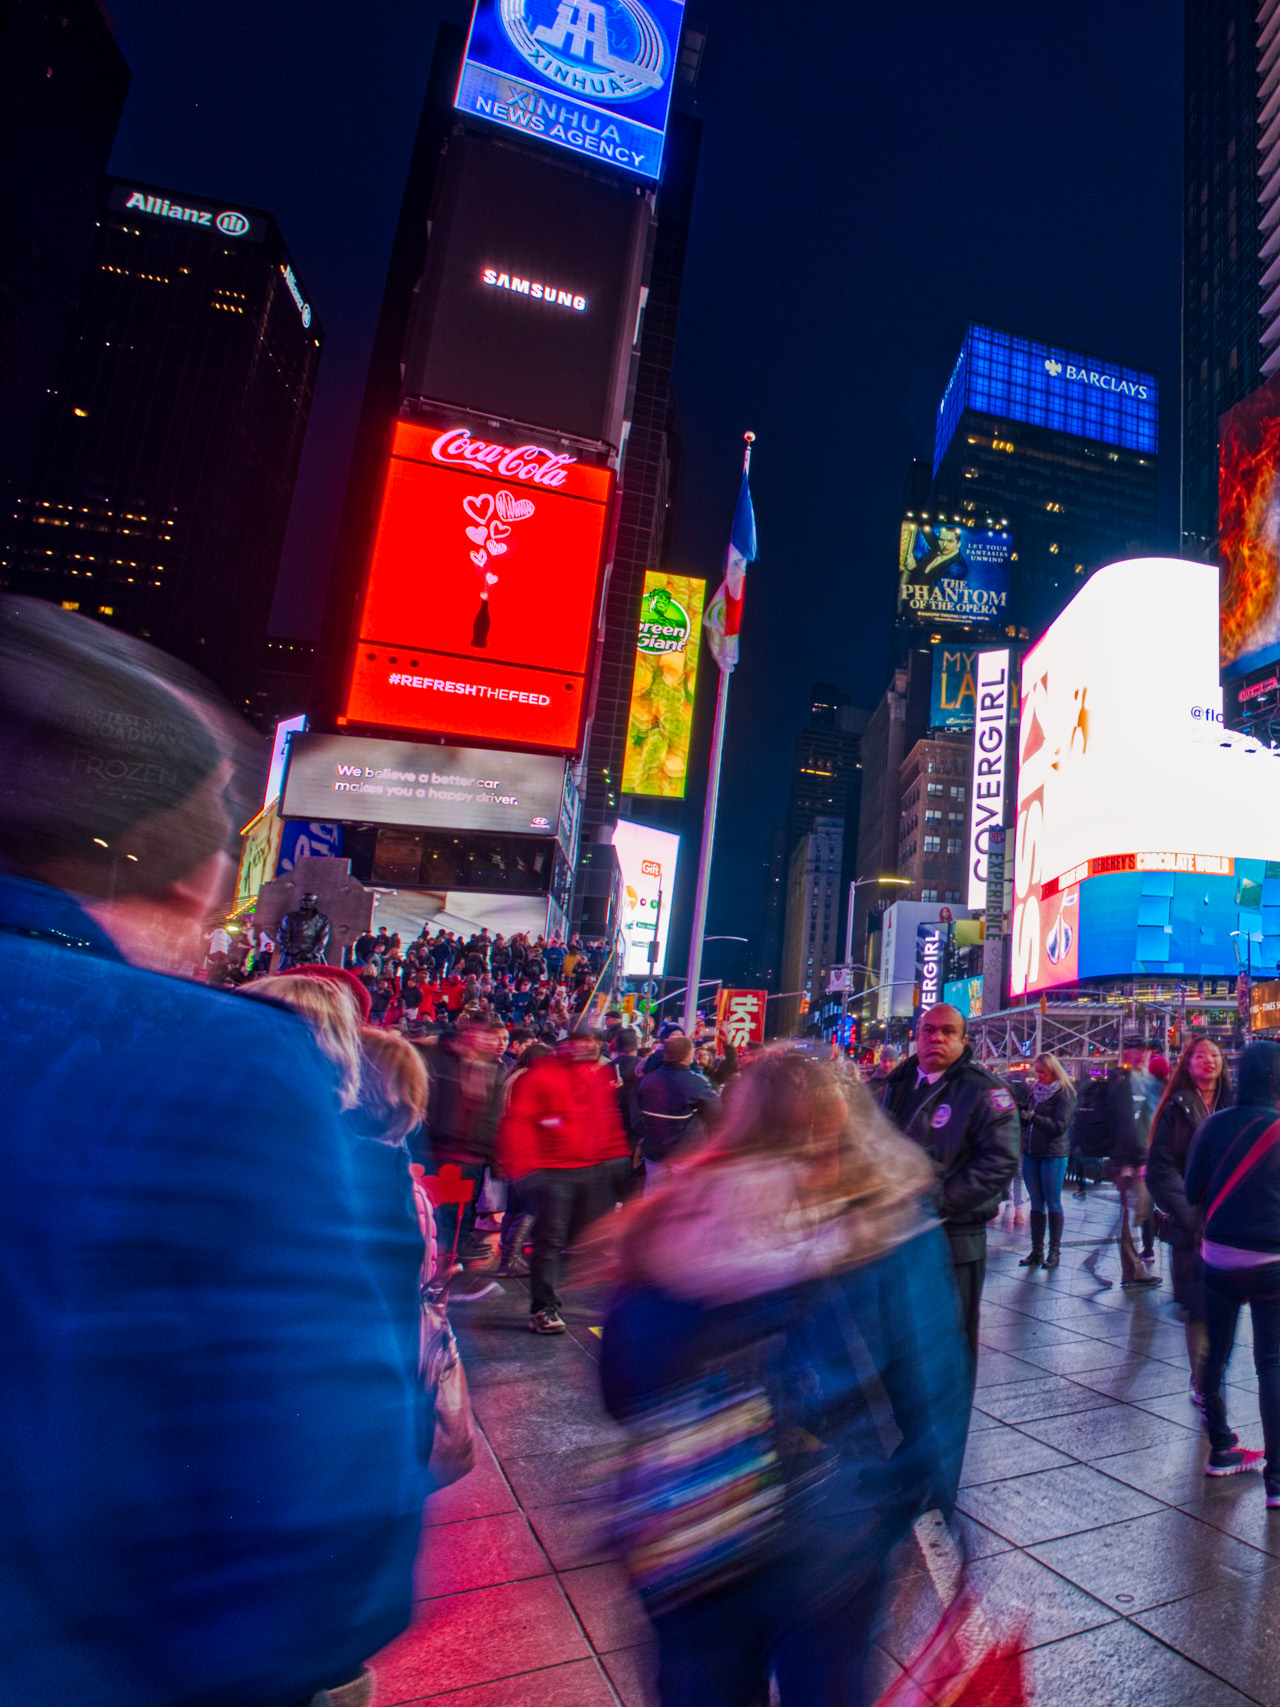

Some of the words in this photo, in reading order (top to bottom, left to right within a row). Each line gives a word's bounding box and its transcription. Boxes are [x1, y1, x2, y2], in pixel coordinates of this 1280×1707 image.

[527, 49, 624, 94] XINHUA
[507, 86, 622, 143] XINHUA
[476, 96, 545, 132] NEWS
[549, 125, 645, 167] AGENCY
[126, 192, 213, 226] Allianz
[483, 268, 587, 311] SAMSUNG
[1066, 365, 1148, 399] BARCLAYS
[432, 429, 577, 486] Coca-Cola
[966, 549, 1008, 557] FANTASIES
[970, 555, 1004, 563] UNWIND
[901, 584, 1007, 607] PHANTOM
[941, 578, 968, 589] THE
[909, 599, 927, 609] OF
[929, 600, 955, 611] THE
[956, 603, 998, 615] OPERA
[942, 651, 977, 672] MY
[389, 673, 550, 706] #REFRESHTHEFEED
[337, 765, 362, 777] We
[418, 773, 429, 783] a
[431, 773, 474, 787] better
[476, 779, 500, 789] car
[334, 781, 383, 794] makes
[387, 786, 412, 797] you
[415, 788, 426, 798] a
[429, 787, 473, 803] happy
[476, 793, 519, 805] driver.
[991, 832, 1004, 841] NFL
[642, 862, 659, 875] Gift
[1136, 853, 1194, 871] CHOCOLATE
[986, 852, 1005, 941] EXPERIENCE
[1262, 1001, 1276, 1011] TIMES
[729, 994, 759, 1047] tkts
